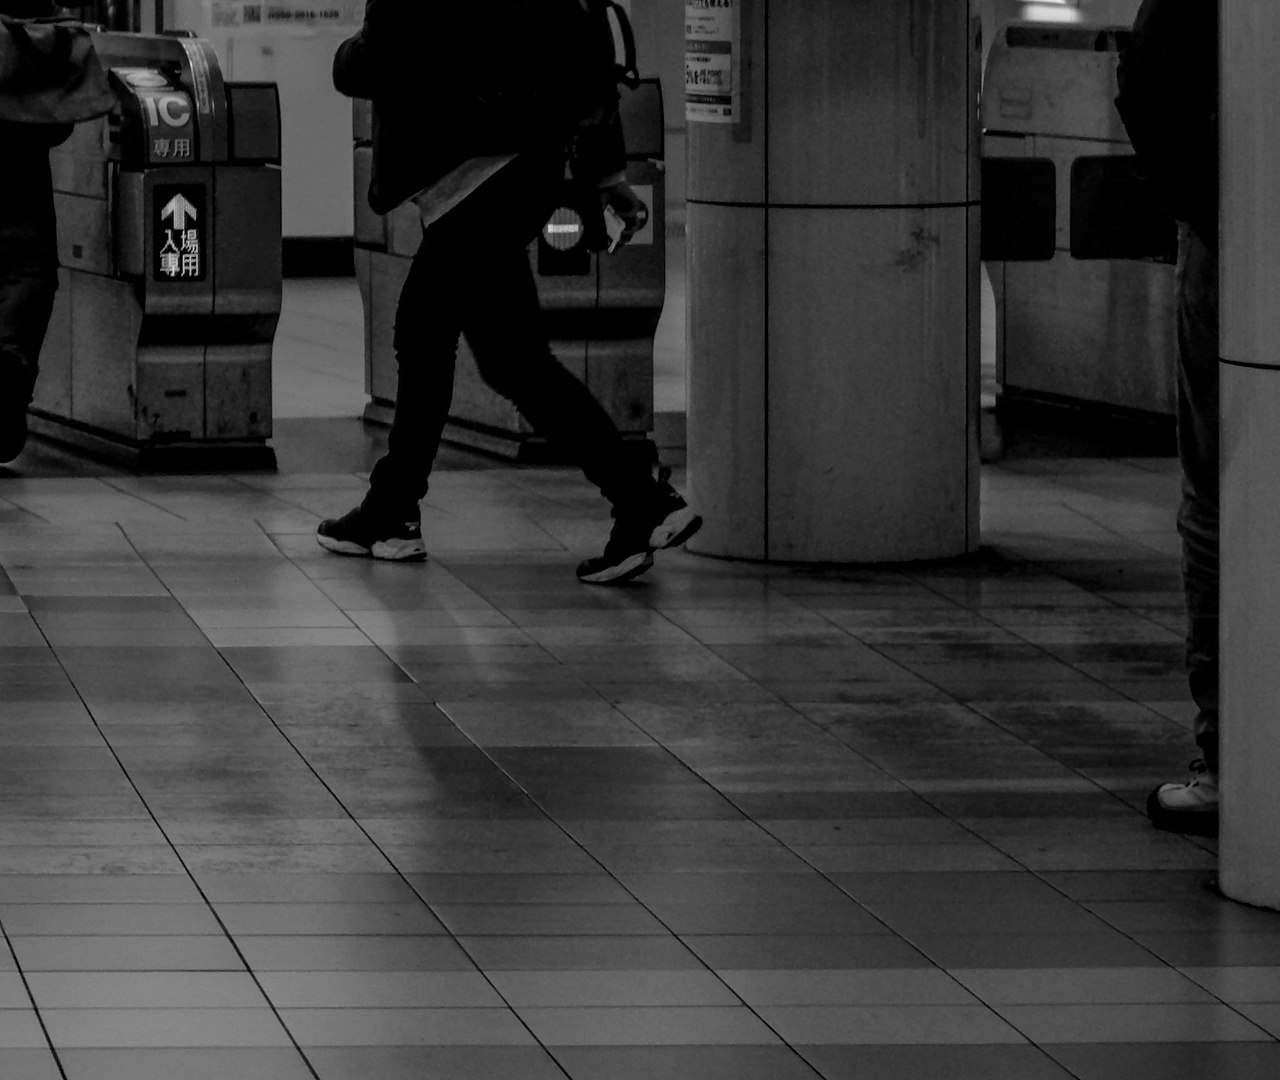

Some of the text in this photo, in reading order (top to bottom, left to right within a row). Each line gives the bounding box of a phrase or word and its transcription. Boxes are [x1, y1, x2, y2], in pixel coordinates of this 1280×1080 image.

[144, 96, 191, 127] IC
[153, 138, 191, 158] 専用
[159, 228, 199, 253] 入場
[159, 252, 200, 278] 専用
